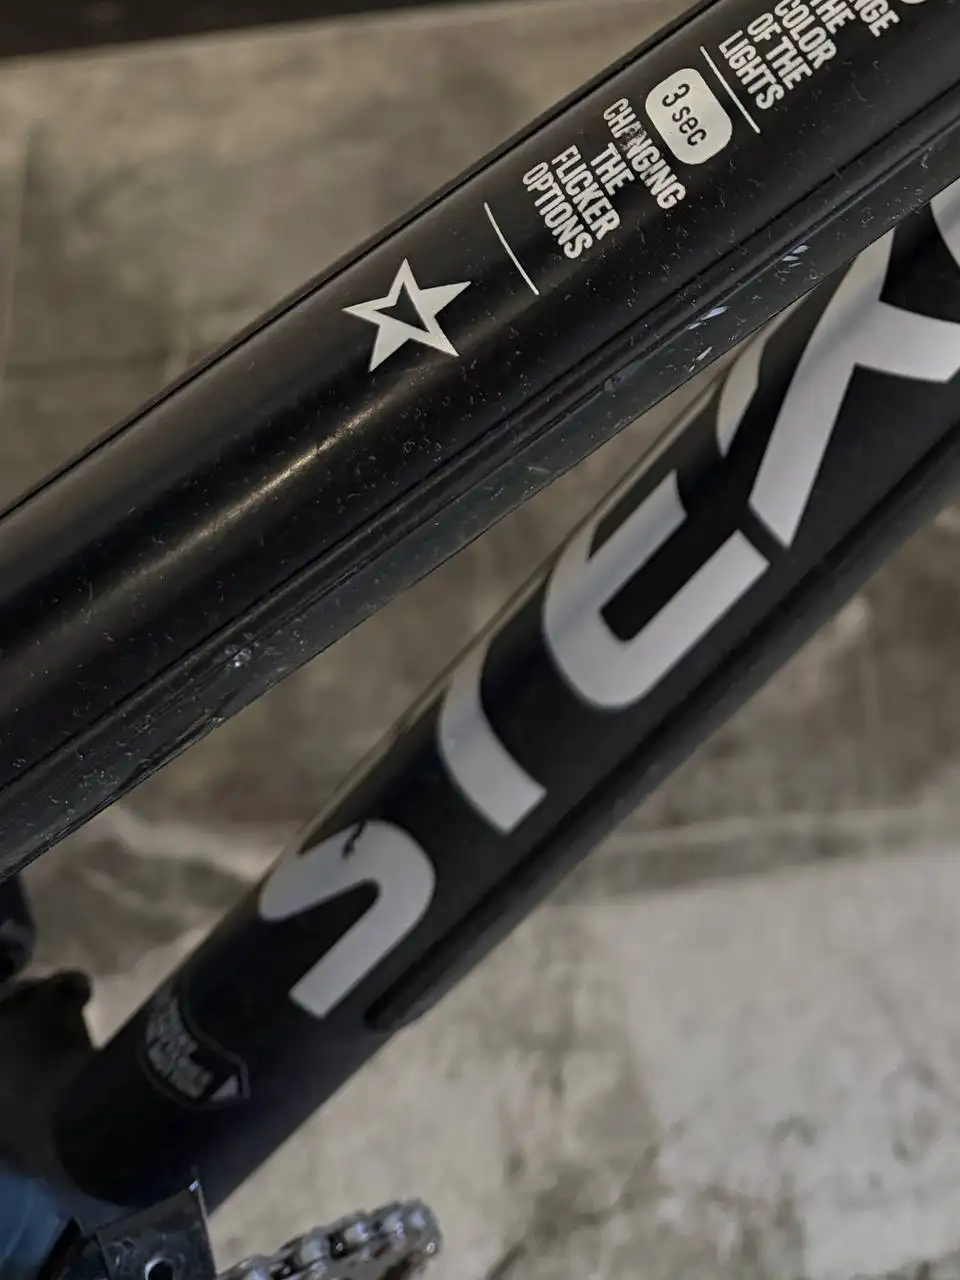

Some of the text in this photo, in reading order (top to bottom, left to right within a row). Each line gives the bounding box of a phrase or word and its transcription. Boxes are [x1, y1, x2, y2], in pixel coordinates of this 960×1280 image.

[718, 30, 785, 110] LIGHTS
[747, 12, 813, 90] OF THE
[551, 144, 621, 241] FLICKER
[590, 142, 636, 196] THE
[522, 161, 593, 259] OPTIONS
